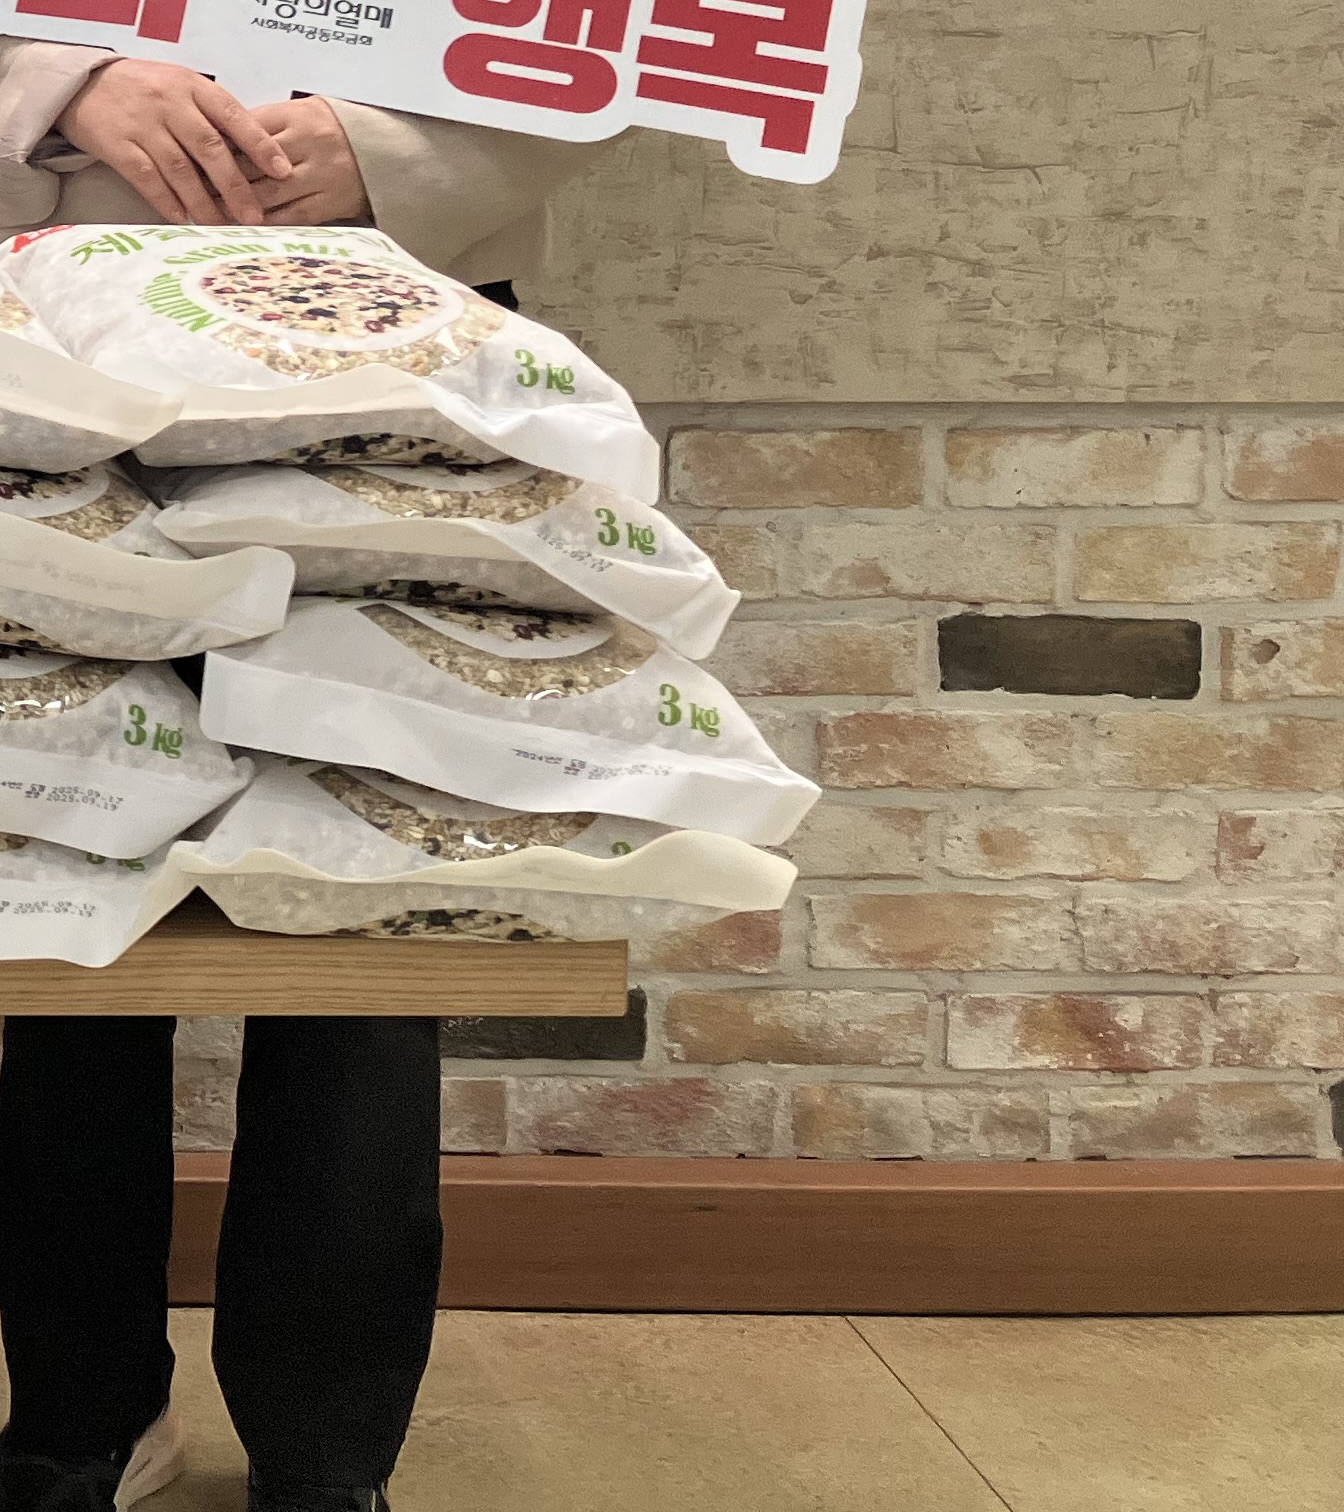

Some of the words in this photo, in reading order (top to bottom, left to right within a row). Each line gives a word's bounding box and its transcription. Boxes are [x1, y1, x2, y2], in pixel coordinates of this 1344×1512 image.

[250, 17, 374, 46] 사회복지공동모금회
[515, 349, 539, 388] 3
[546, 363, 576, 395] kg
[595, 508, 620, 546] 3
[626, 522, 656, 555] kg
[124, 704, 147, 746] 3
[152, 722, 183, 759] kg
[658, 683, 682, 726] 3
[690, 702, 720, 737] kg
